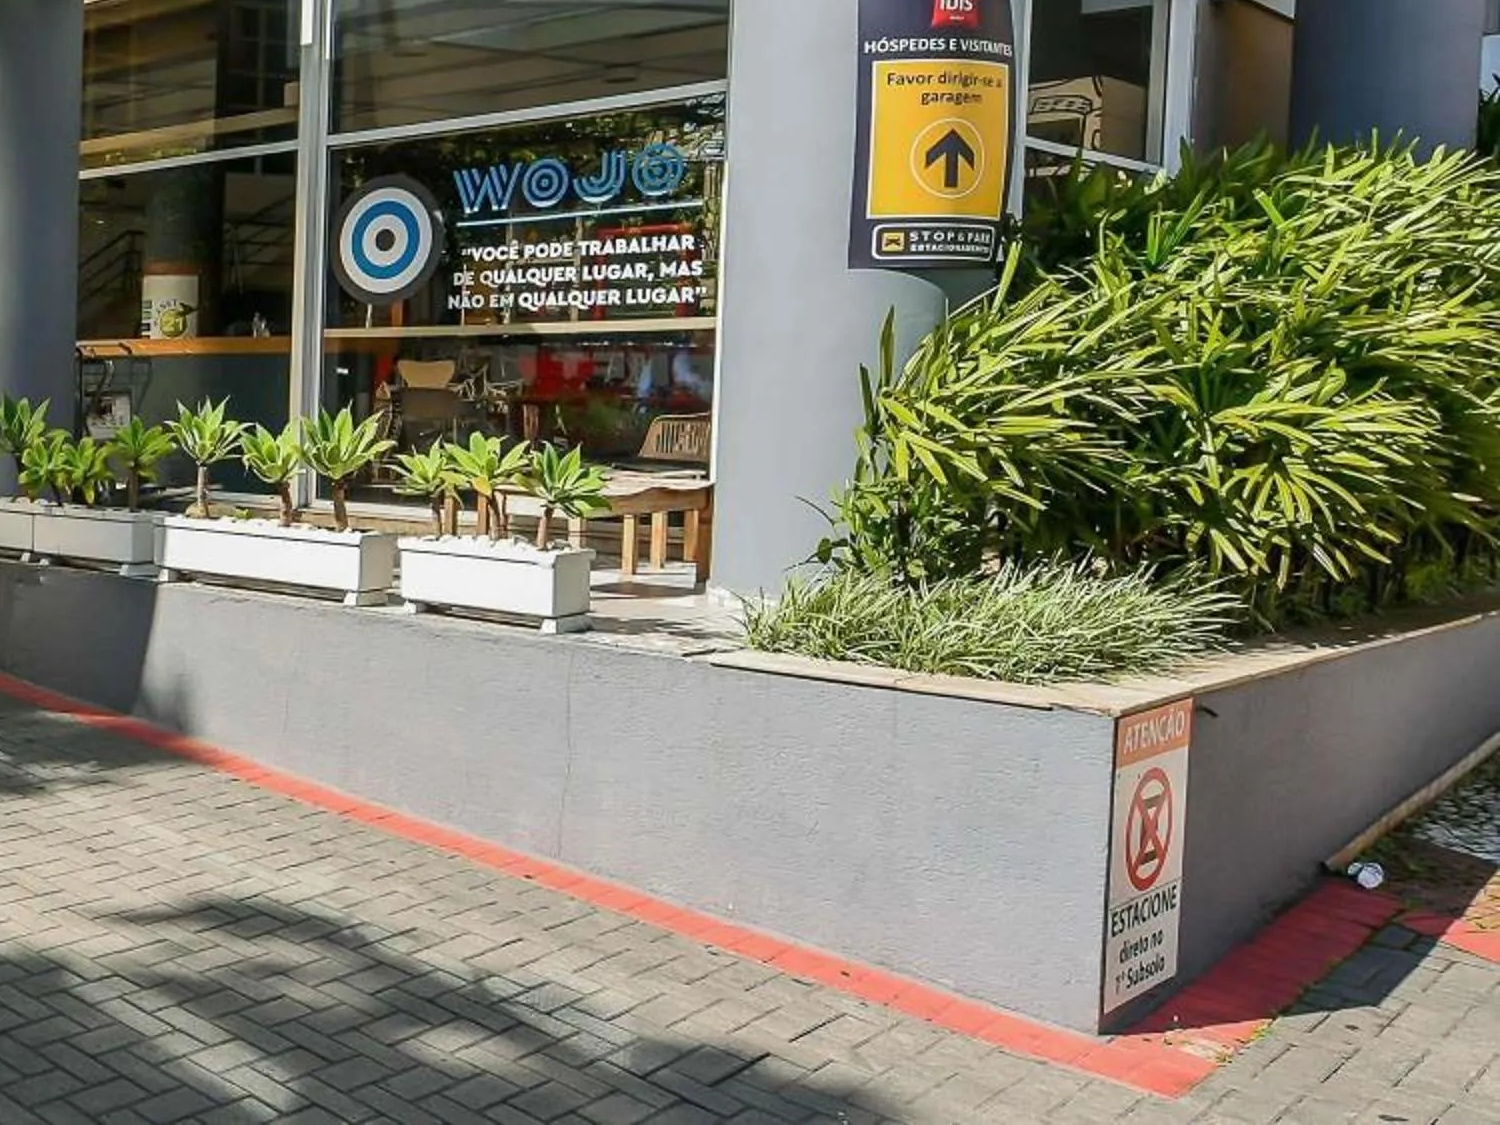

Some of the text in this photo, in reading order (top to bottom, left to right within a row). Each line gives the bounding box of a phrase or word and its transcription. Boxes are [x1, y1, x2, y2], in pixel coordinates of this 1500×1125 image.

[864, 36, 1013, 57] HÓSPEDES E VISITANTES
[887, 72, 932, 86] Favor
[921, 91, 982, 106] garagem
[523, 242, 573, 259] PODE
[578, 235, 695, 257] TRABALHAR
[909, 230, 955, 242] STOP
[453, 260, 703, 288] DE QUALQUER LUGAR, MAS
[447, 290, 485, 309] NÃO
[489, 293, 514, 308] EM
[518, 288, 621, 312] QUALQUER
[1111, 884, 1177, 938] ESTACIONE
[1120, 936, 1149, 964] direto
[1126, 953, 1165, 990] Subsolo
